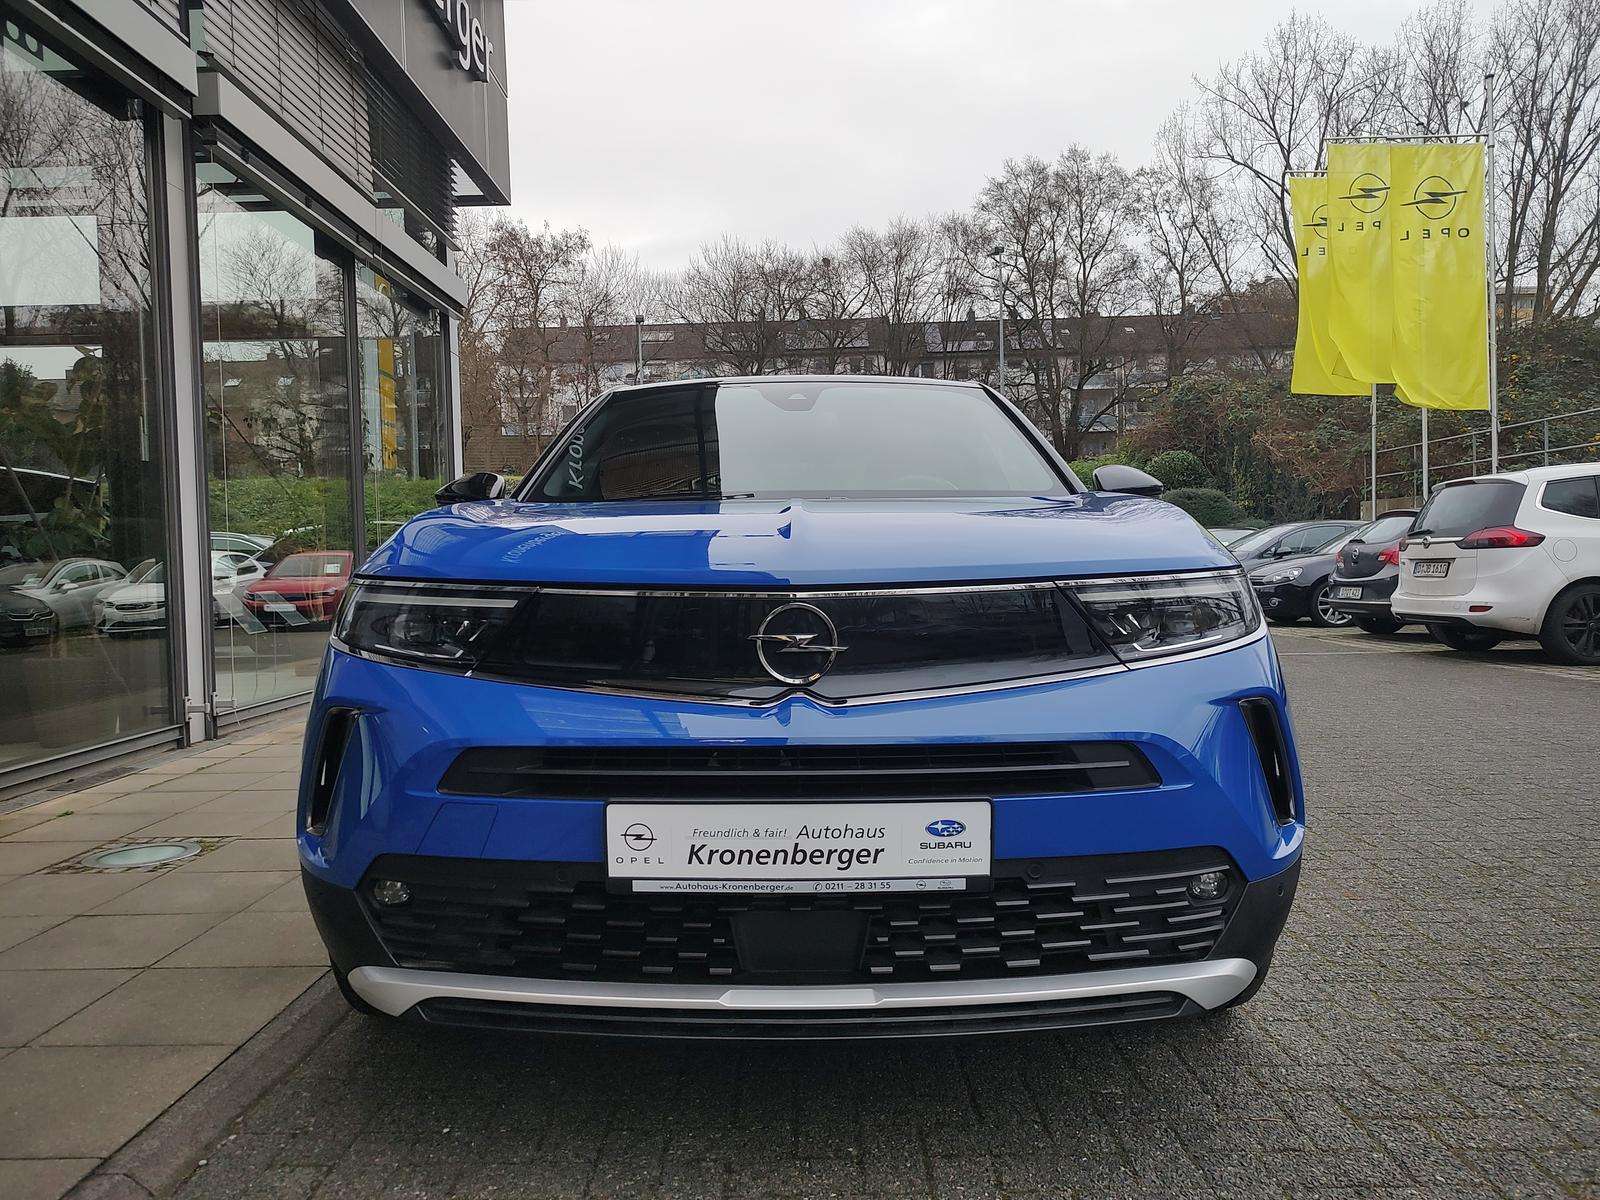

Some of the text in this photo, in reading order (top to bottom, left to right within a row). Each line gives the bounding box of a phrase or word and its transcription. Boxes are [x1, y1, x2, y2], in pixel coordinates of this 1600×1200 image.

[692, 824, 886, 840] Freundlich & fair! Autohaus
[919, 842, 972, 850] SUBARU
[616, 856, 664, 864] OPEL
[687, 842, 885, 871] Kronenberger
[660, 882, 794, 892] www.Autohaus-Kronenberger.de
[867, 882, 877, 890] 31
